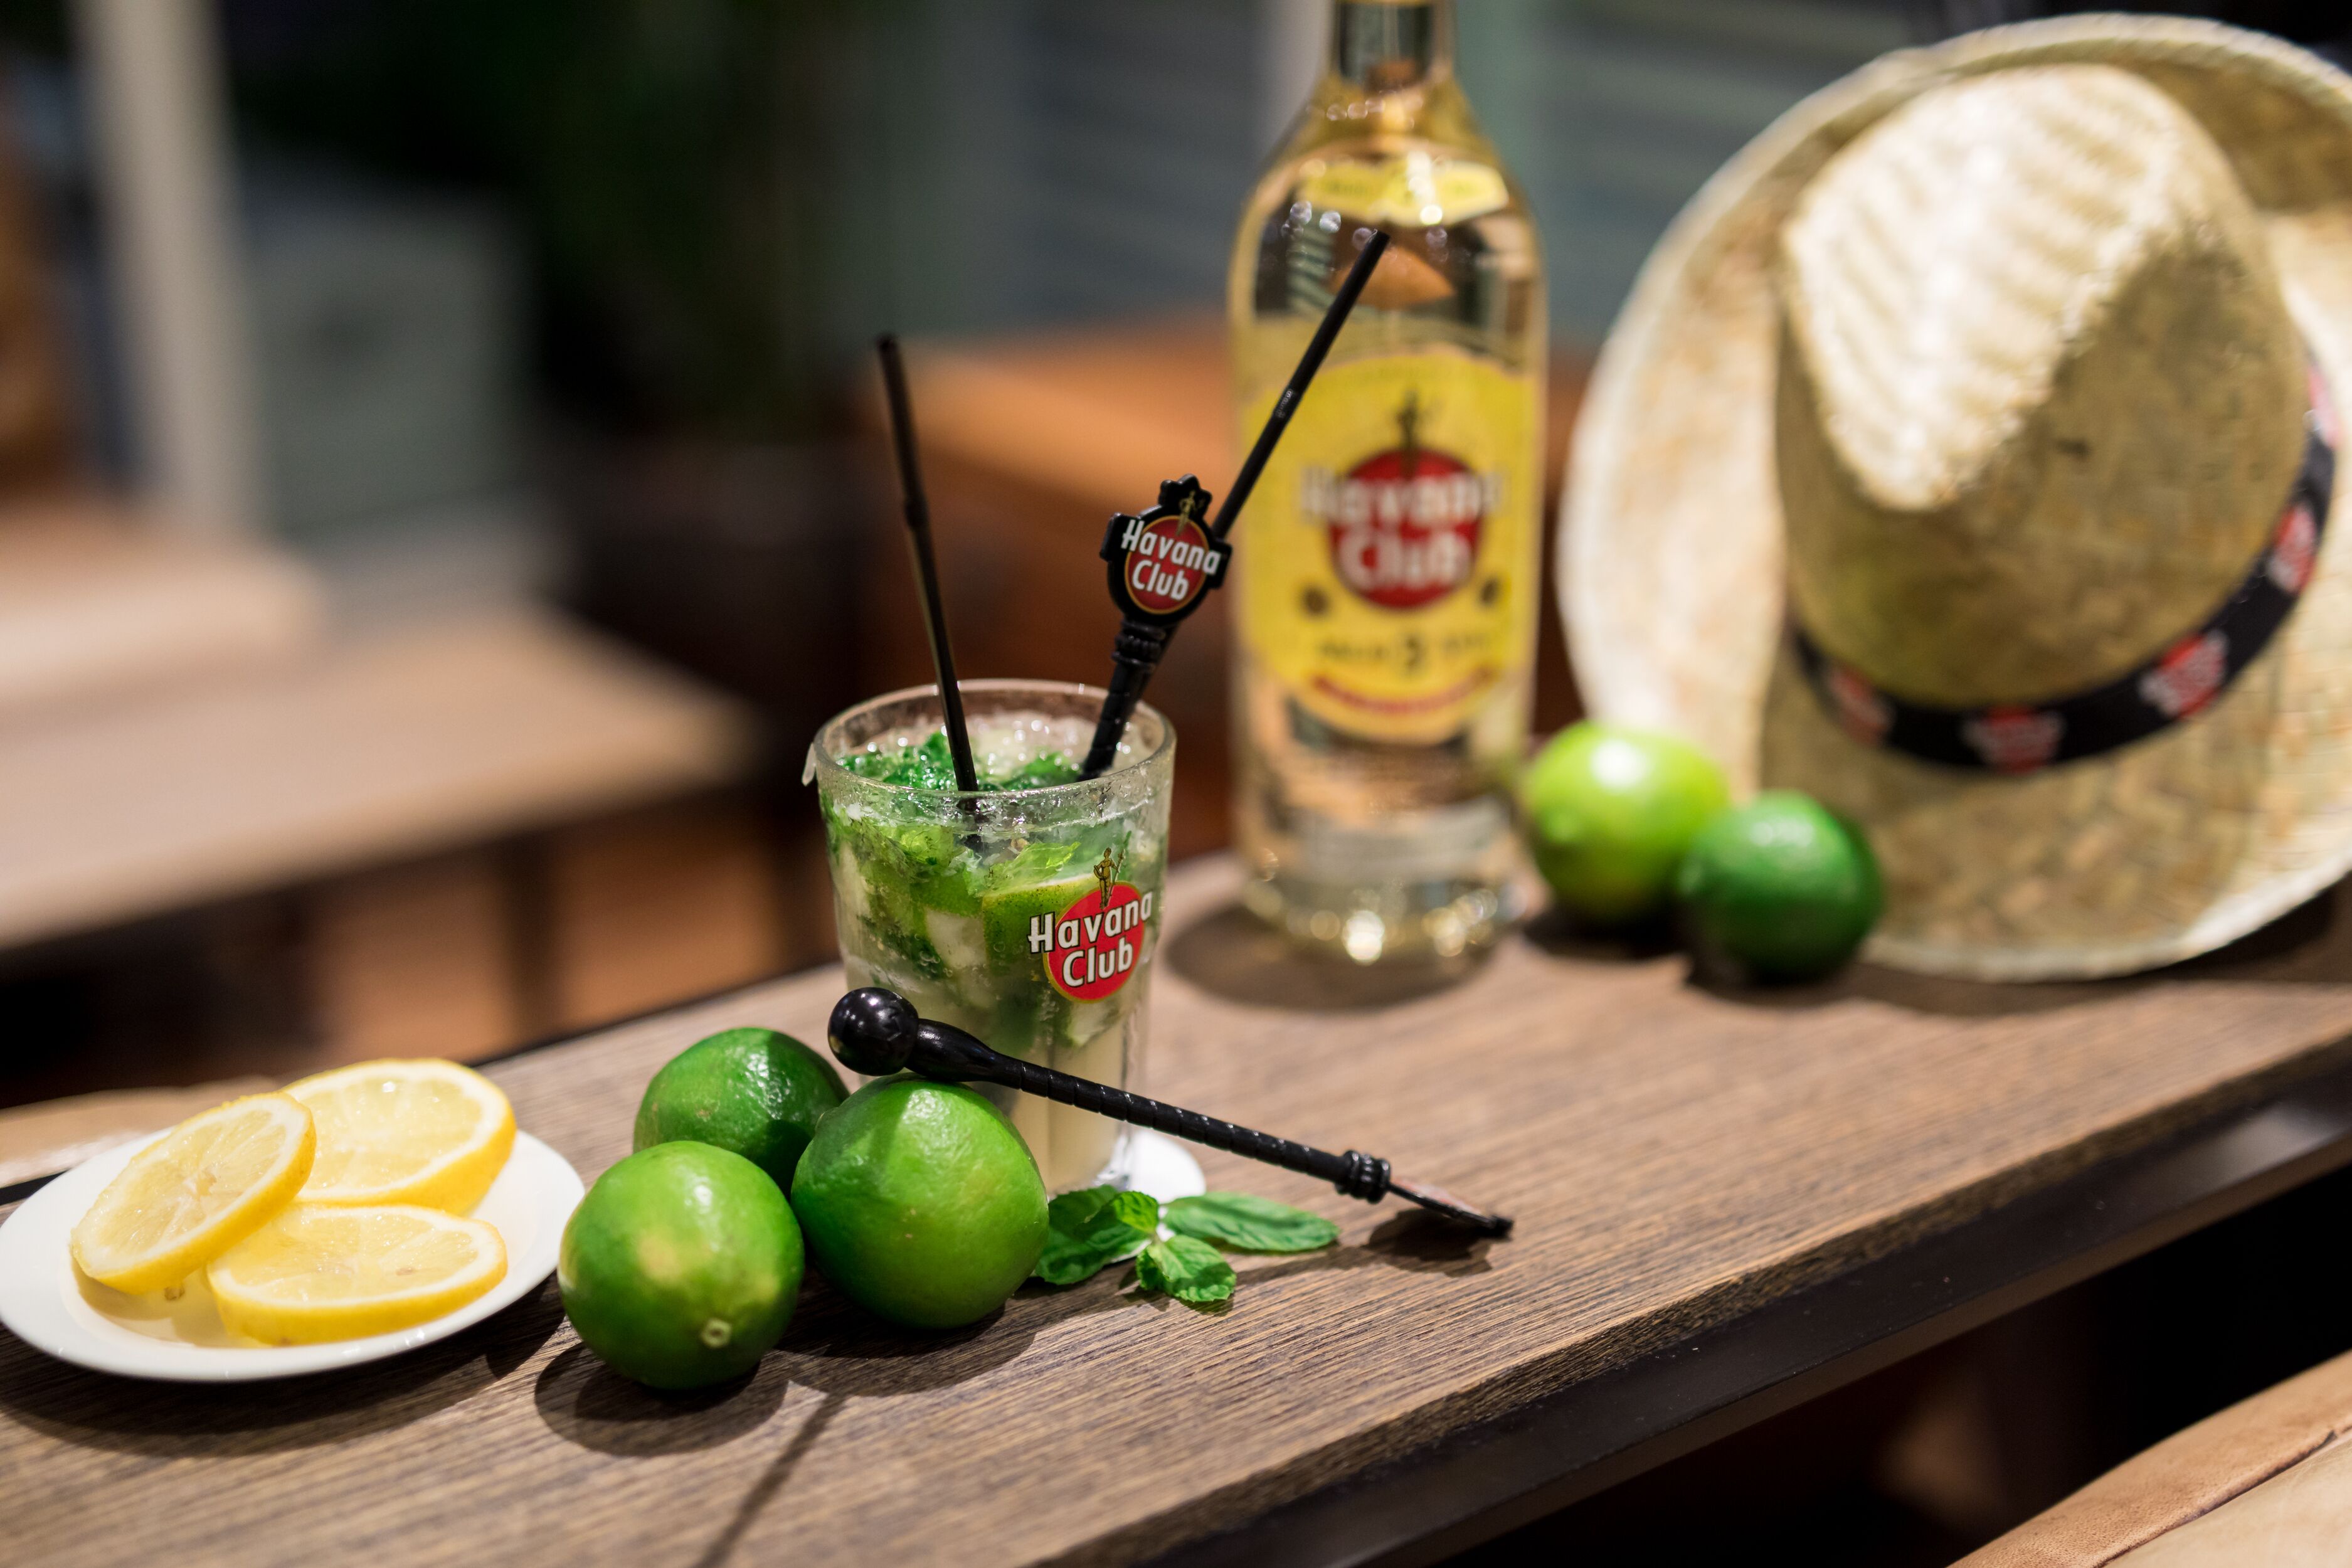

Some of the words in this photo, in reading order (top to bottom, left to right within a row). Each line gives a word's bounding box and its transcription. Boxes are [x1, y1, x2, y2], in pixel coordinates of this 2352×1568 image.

[1120, 519, 1221, 576] Havana
[1131, 559, 1189, 601] Club
[1027, 891, 1153, 955] Havana
[1062, 936, 1134, 988] Club
